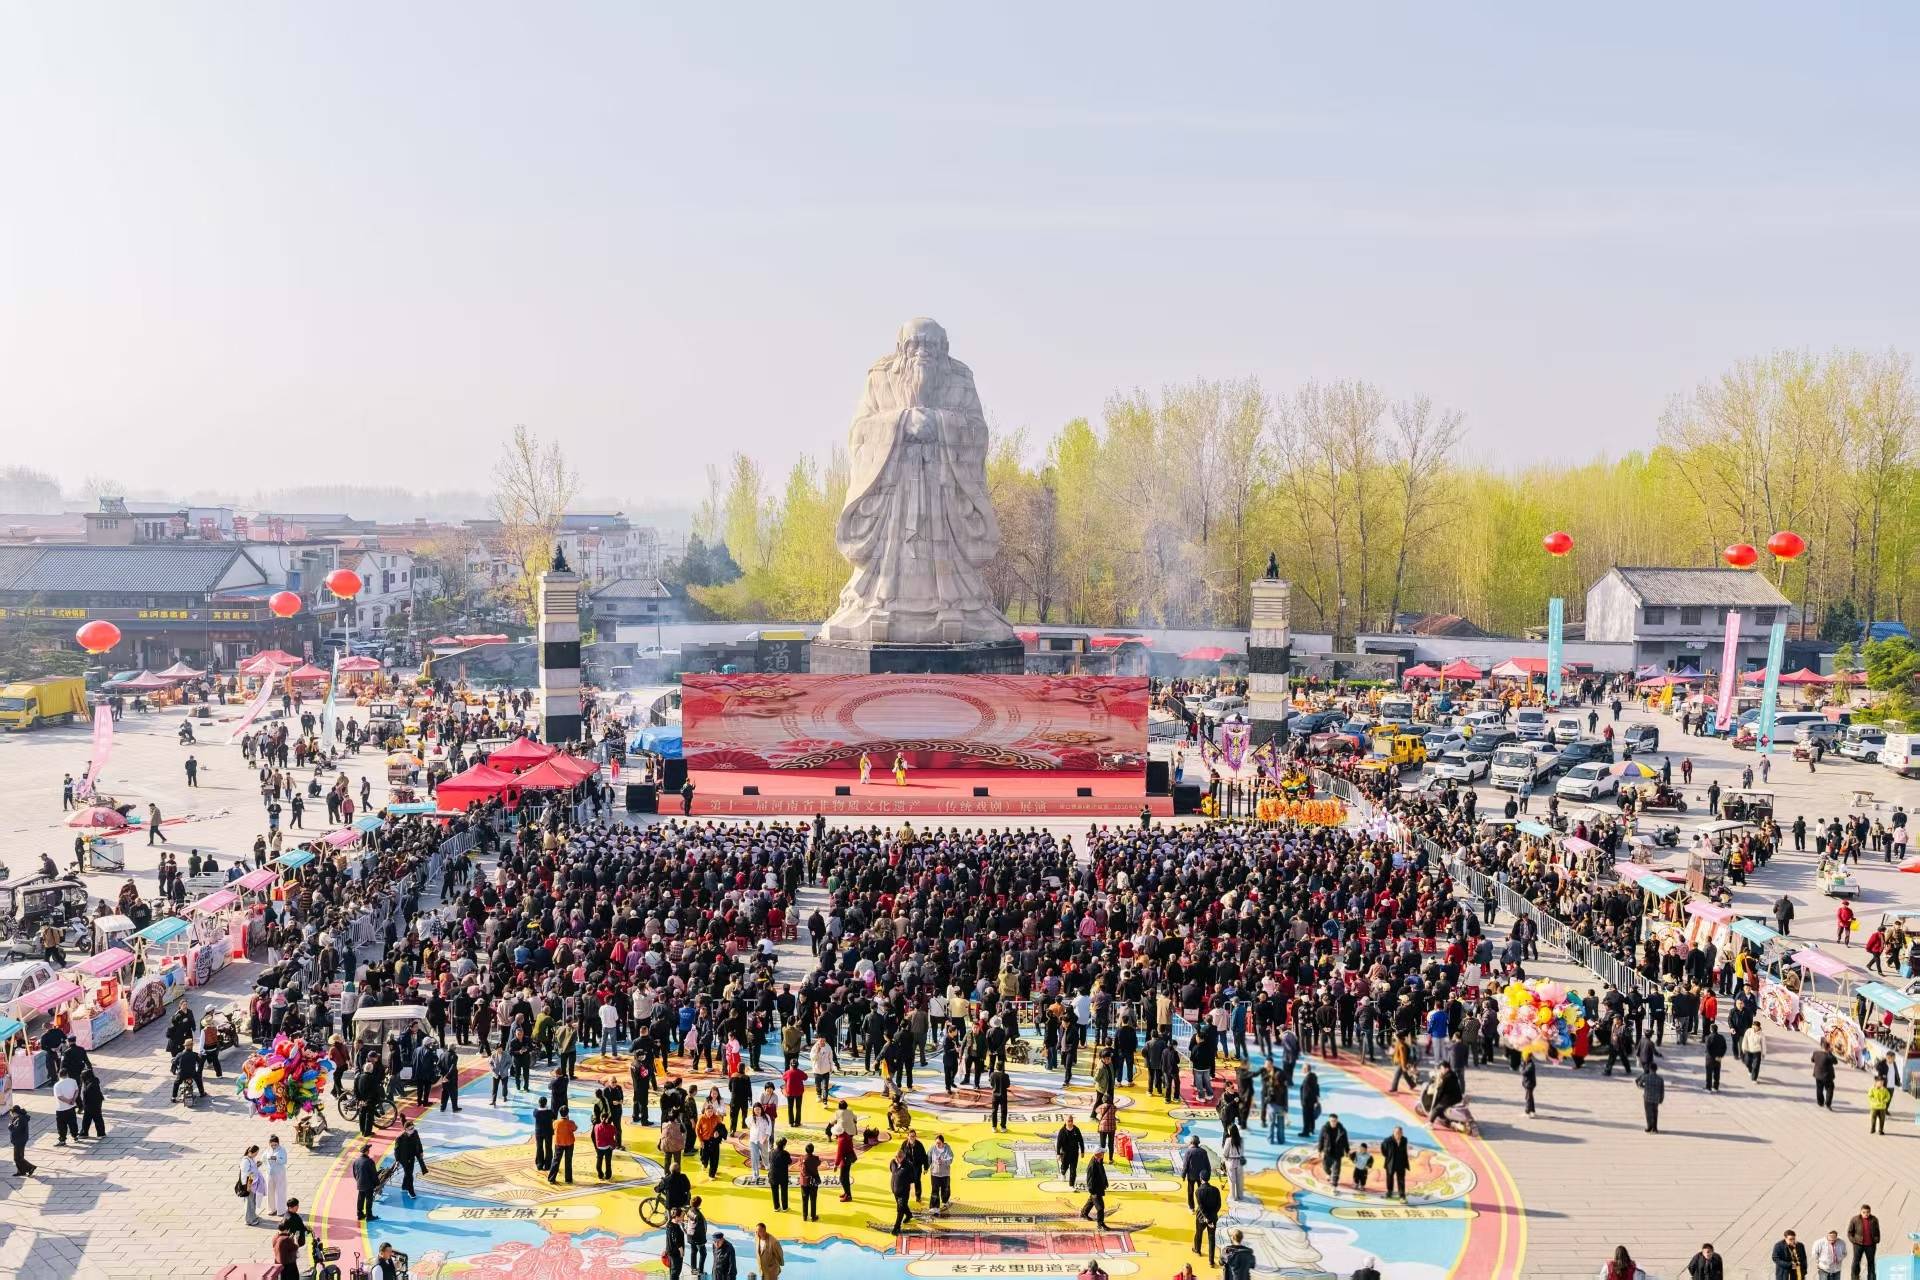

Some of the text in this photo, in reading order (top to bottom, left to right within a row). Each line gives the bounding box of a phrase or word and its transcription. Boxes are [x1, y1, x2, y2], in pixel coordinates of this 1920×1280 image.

[459, 1207, 565, 1219] 观堂麻片
[951, 1263, 1082, 1274] 老子故里明道宫
